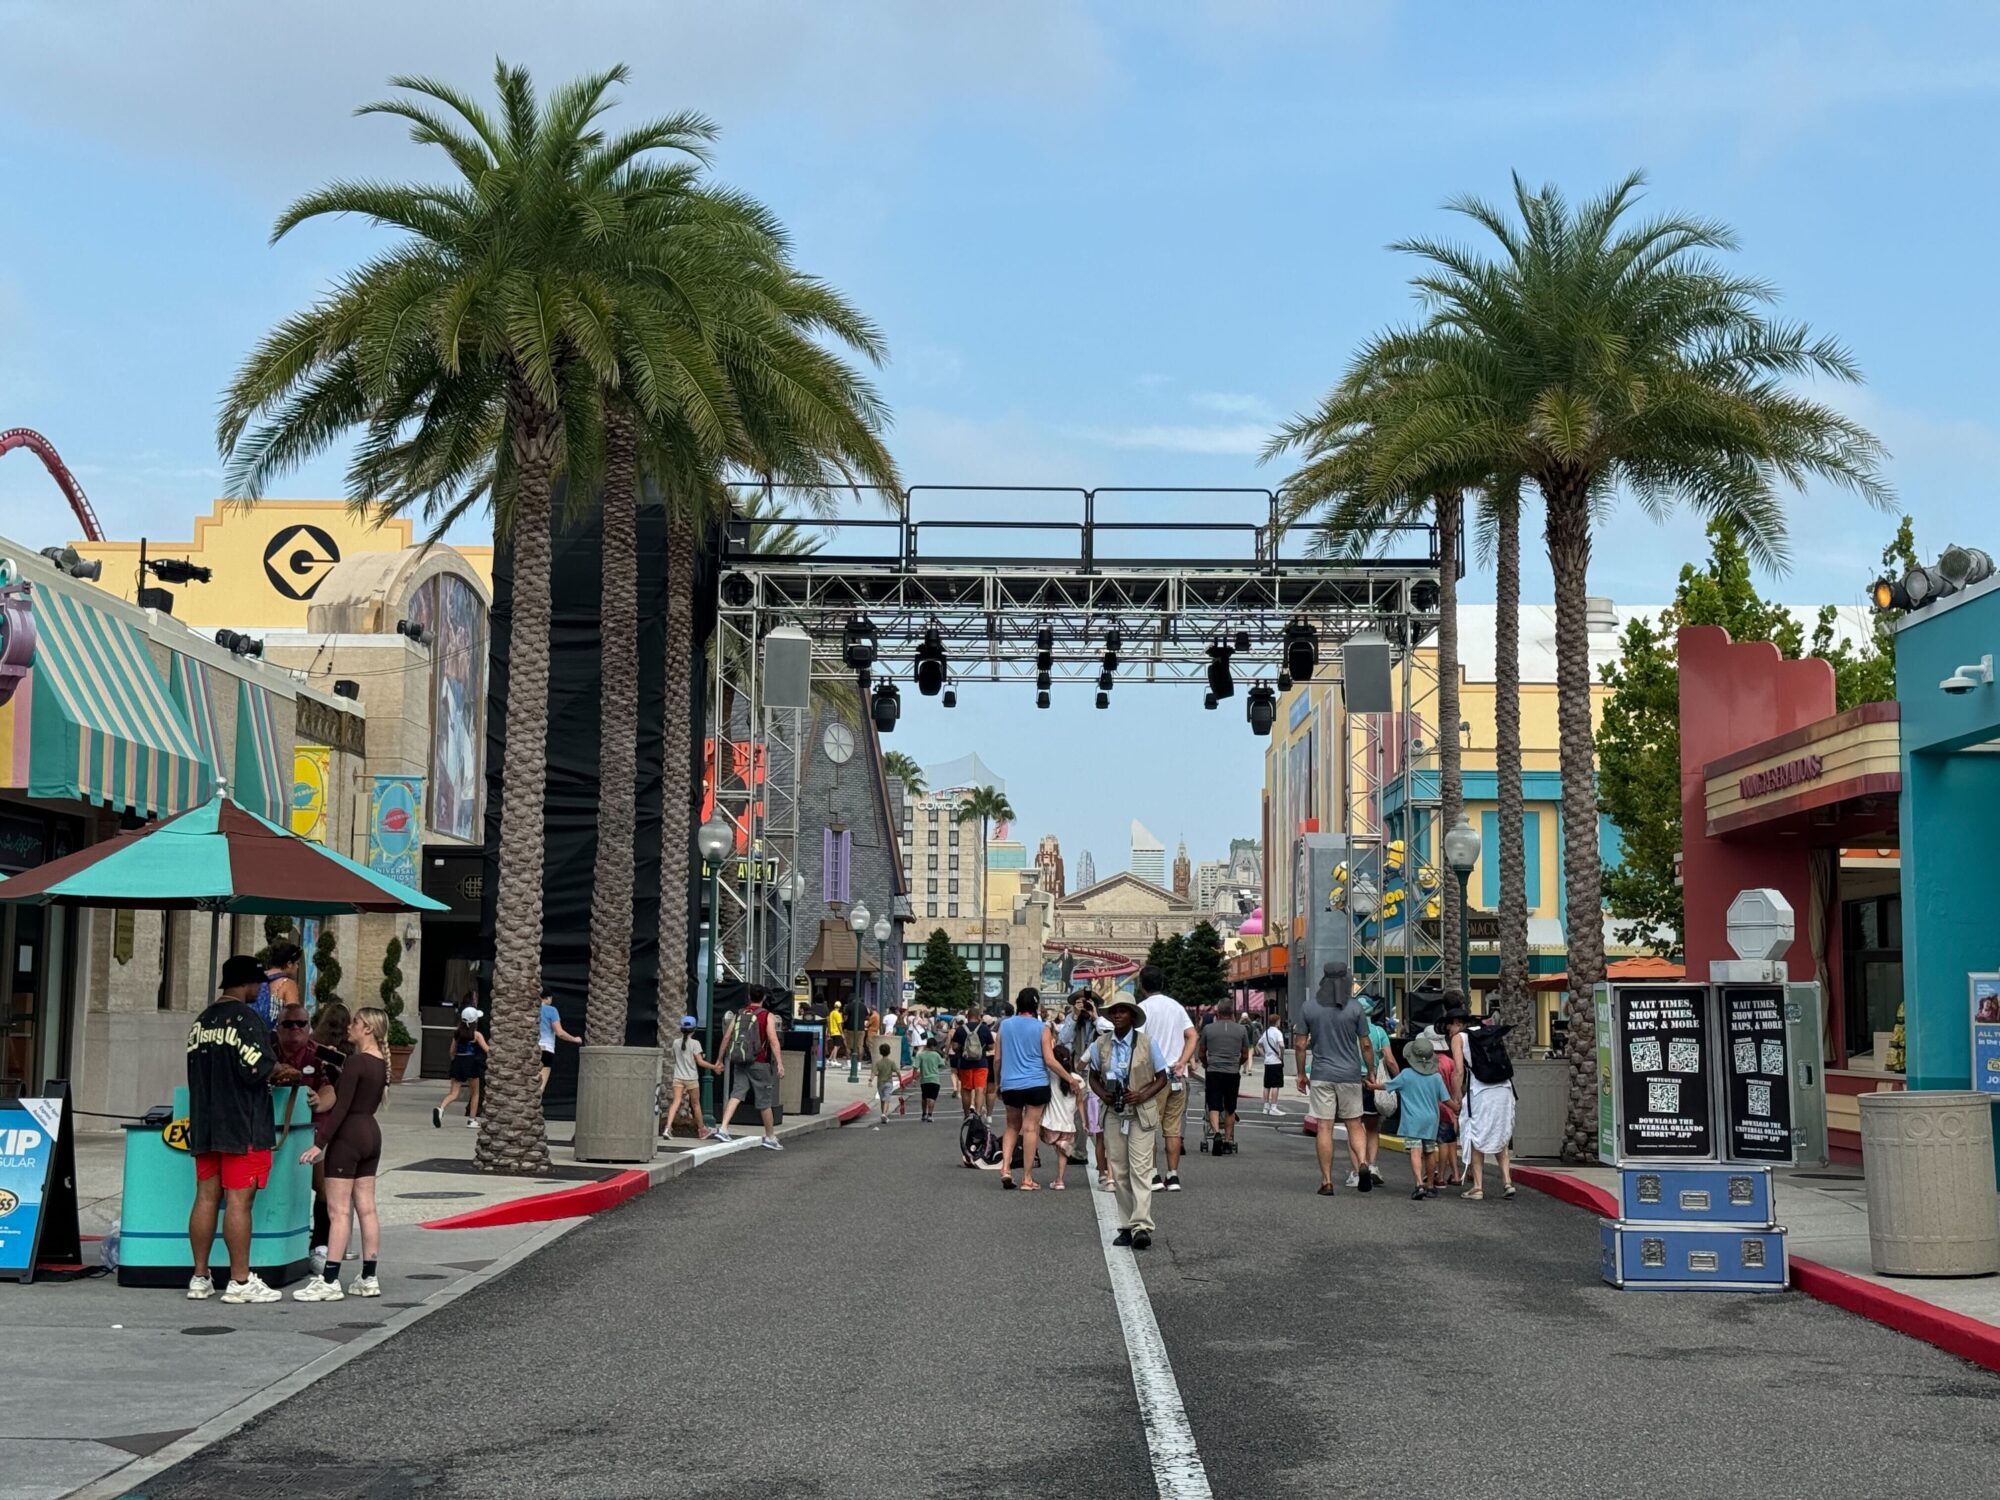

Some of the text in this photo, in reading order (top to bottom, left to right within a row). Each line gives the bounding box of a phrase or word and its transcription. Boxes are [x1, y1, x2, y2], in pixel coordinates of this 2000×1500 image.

[1630, 998, 1693, 1009] WAIT TIMES,
[1732, 999, 1778, 1009] WAIT TIMES,
[1629, 1009, 1696, 1020] SHOW TIMES,
[1732, 1010, 1780, 1020] SHOW TIMES,
[1627, 1019, 1700, 1031] MAPS, & MORE
[1731, 1020, 1783, 1032] MAPS, & MORE
[1741, 1120, 1770, 1128] DOWNLOAD
[1735, 1126, 1764, 1134] UNIVERSAL
